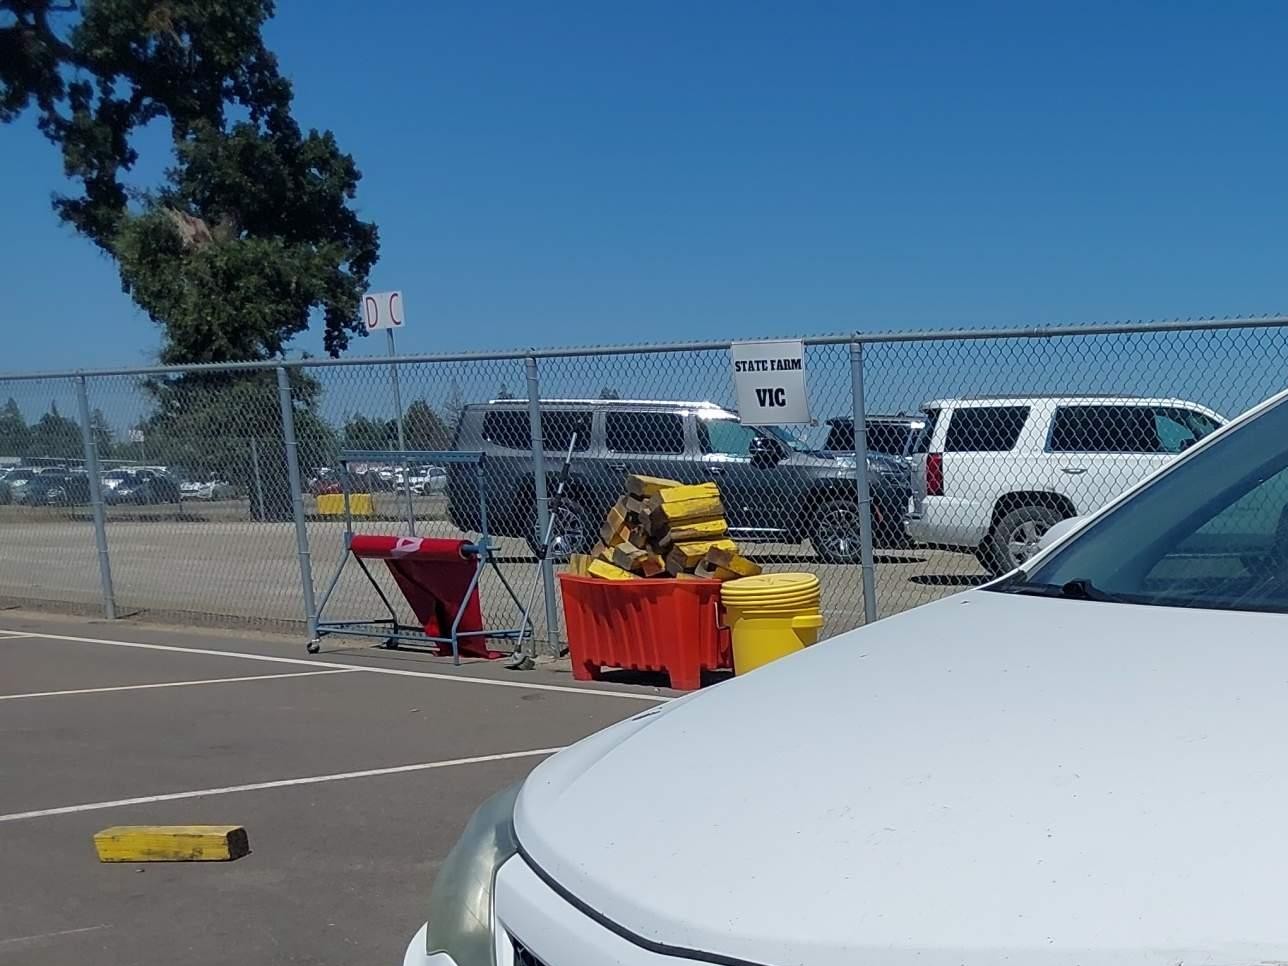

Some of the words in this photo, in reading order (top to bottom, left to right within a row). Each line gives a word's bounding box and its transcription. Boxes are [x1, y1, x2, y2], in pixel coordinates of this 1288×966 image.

[735, 360, 768, 372] STATE
[769, 359, 802, 371] FARM
[755, 387, 786, 407] VIC
